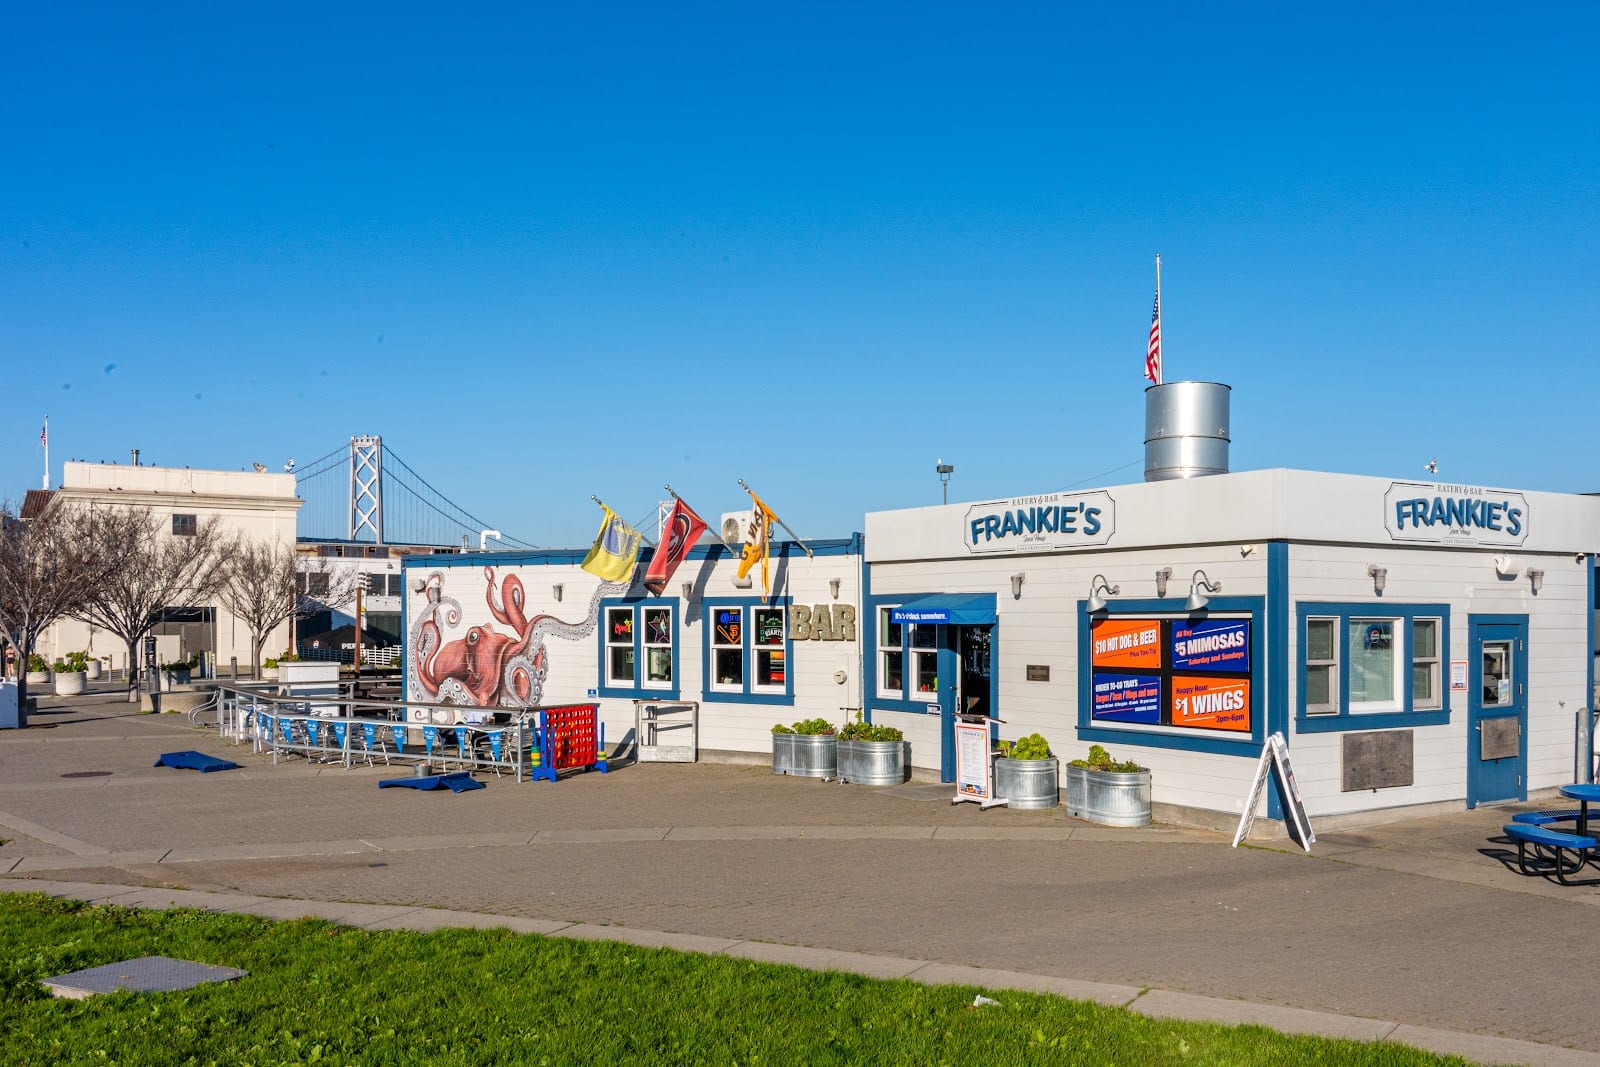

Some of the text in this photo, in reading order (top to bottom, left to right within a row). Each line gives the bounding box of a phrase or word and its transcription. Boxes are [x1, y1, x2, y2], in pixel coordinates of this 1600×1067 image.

[1012, 498, 1038, 506] EATERY
[1044, 494, 1059, 502] BAR
[1438, 485, 1483, 496] EATERY & BAR
[971, 502, 1101, 545] FRANKIE'S
[1396, 497, 1522, 536] FRANKIE'S
[788, 604, 856, 641] BAR
[1095, 629, 1157, 656] $10 HOT DOG & BEER
[1175, 631, 1245, 656] $5 MIMOSAS
[1211, 654, 1221, 662] and
[1175, 687, 1193, 695] Happy
[1175, 697, 1188, 716] $1
[1192, 689, 1244, 715] WINGS
